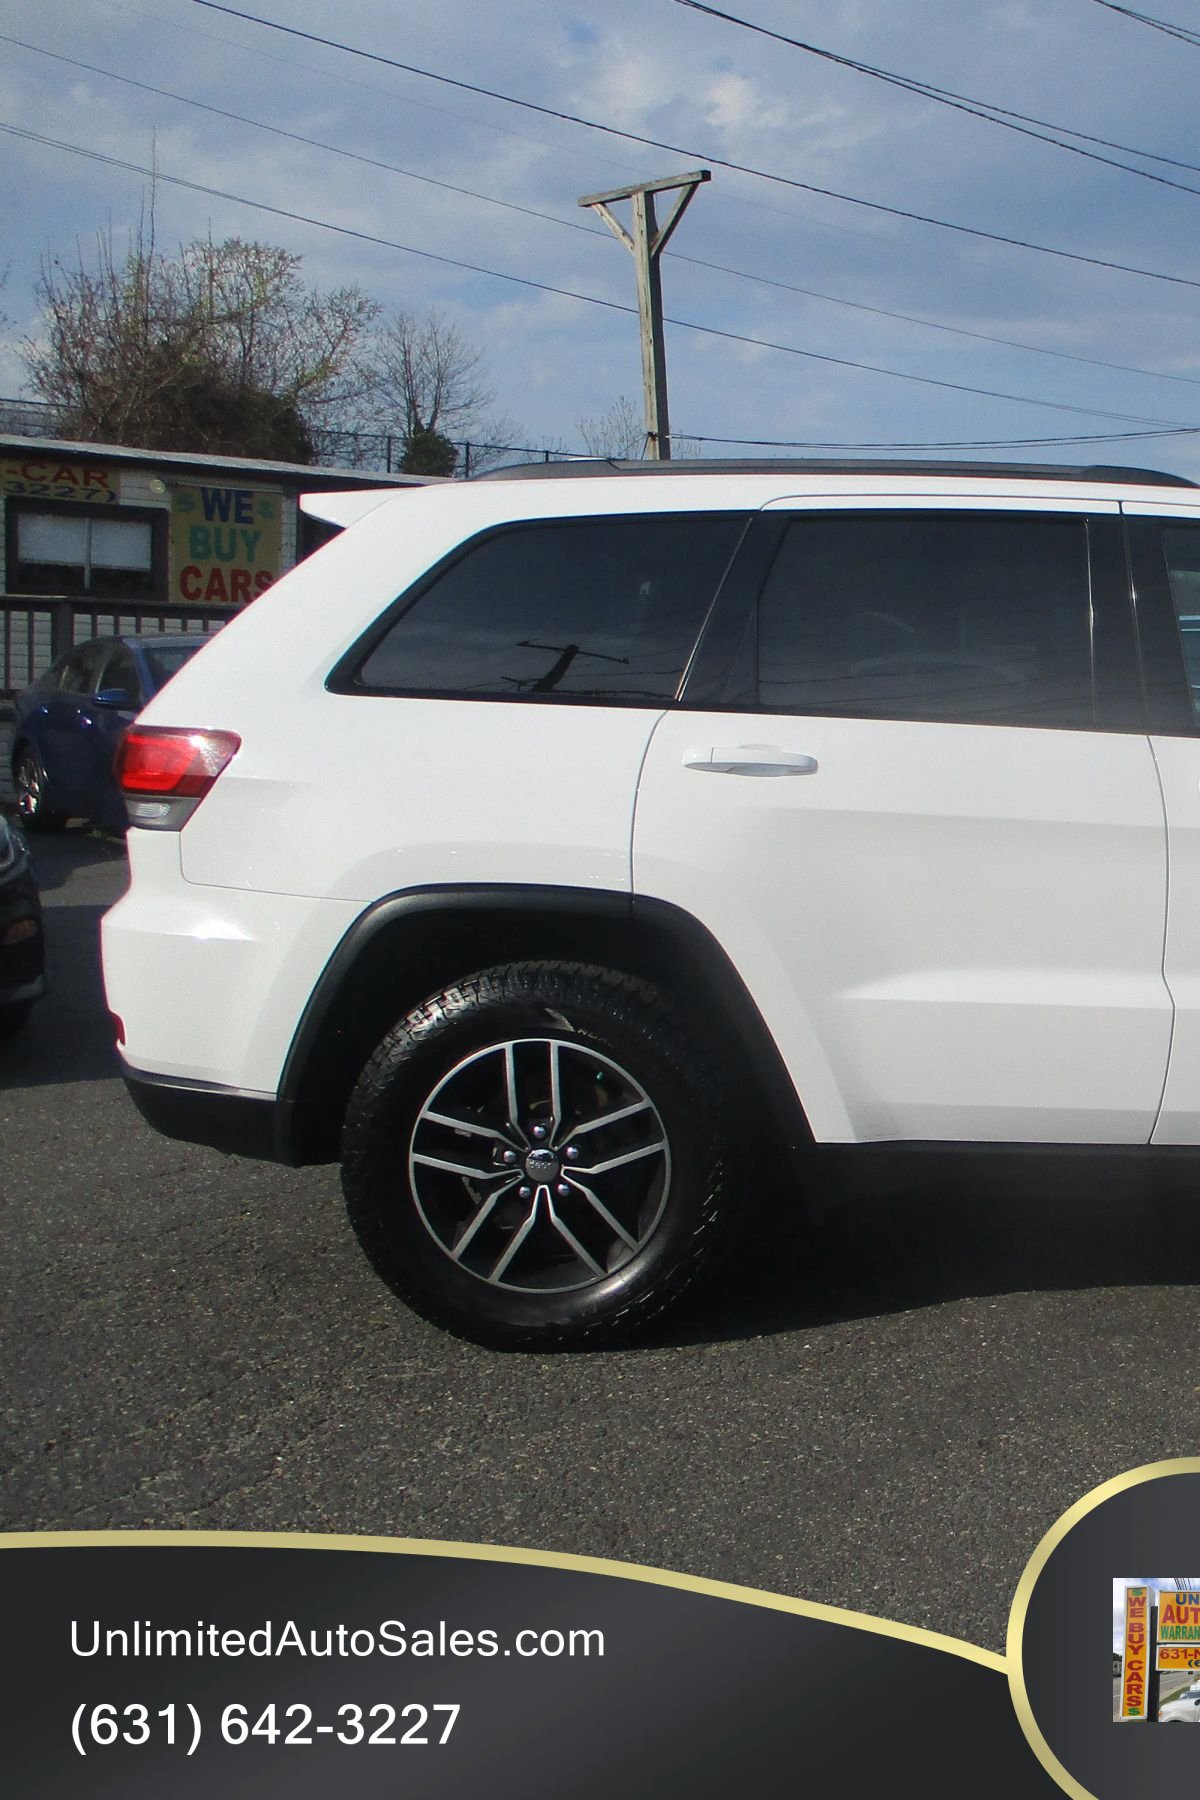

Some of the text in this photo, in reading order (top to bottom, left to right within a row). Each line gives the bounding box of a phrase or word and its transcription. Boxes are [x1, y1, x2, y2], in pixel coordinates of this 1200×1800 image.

[200, 486, 255, 524] WE
[190, 526, 261, 563] BUY
[180, 565, 274, 603] CARS
